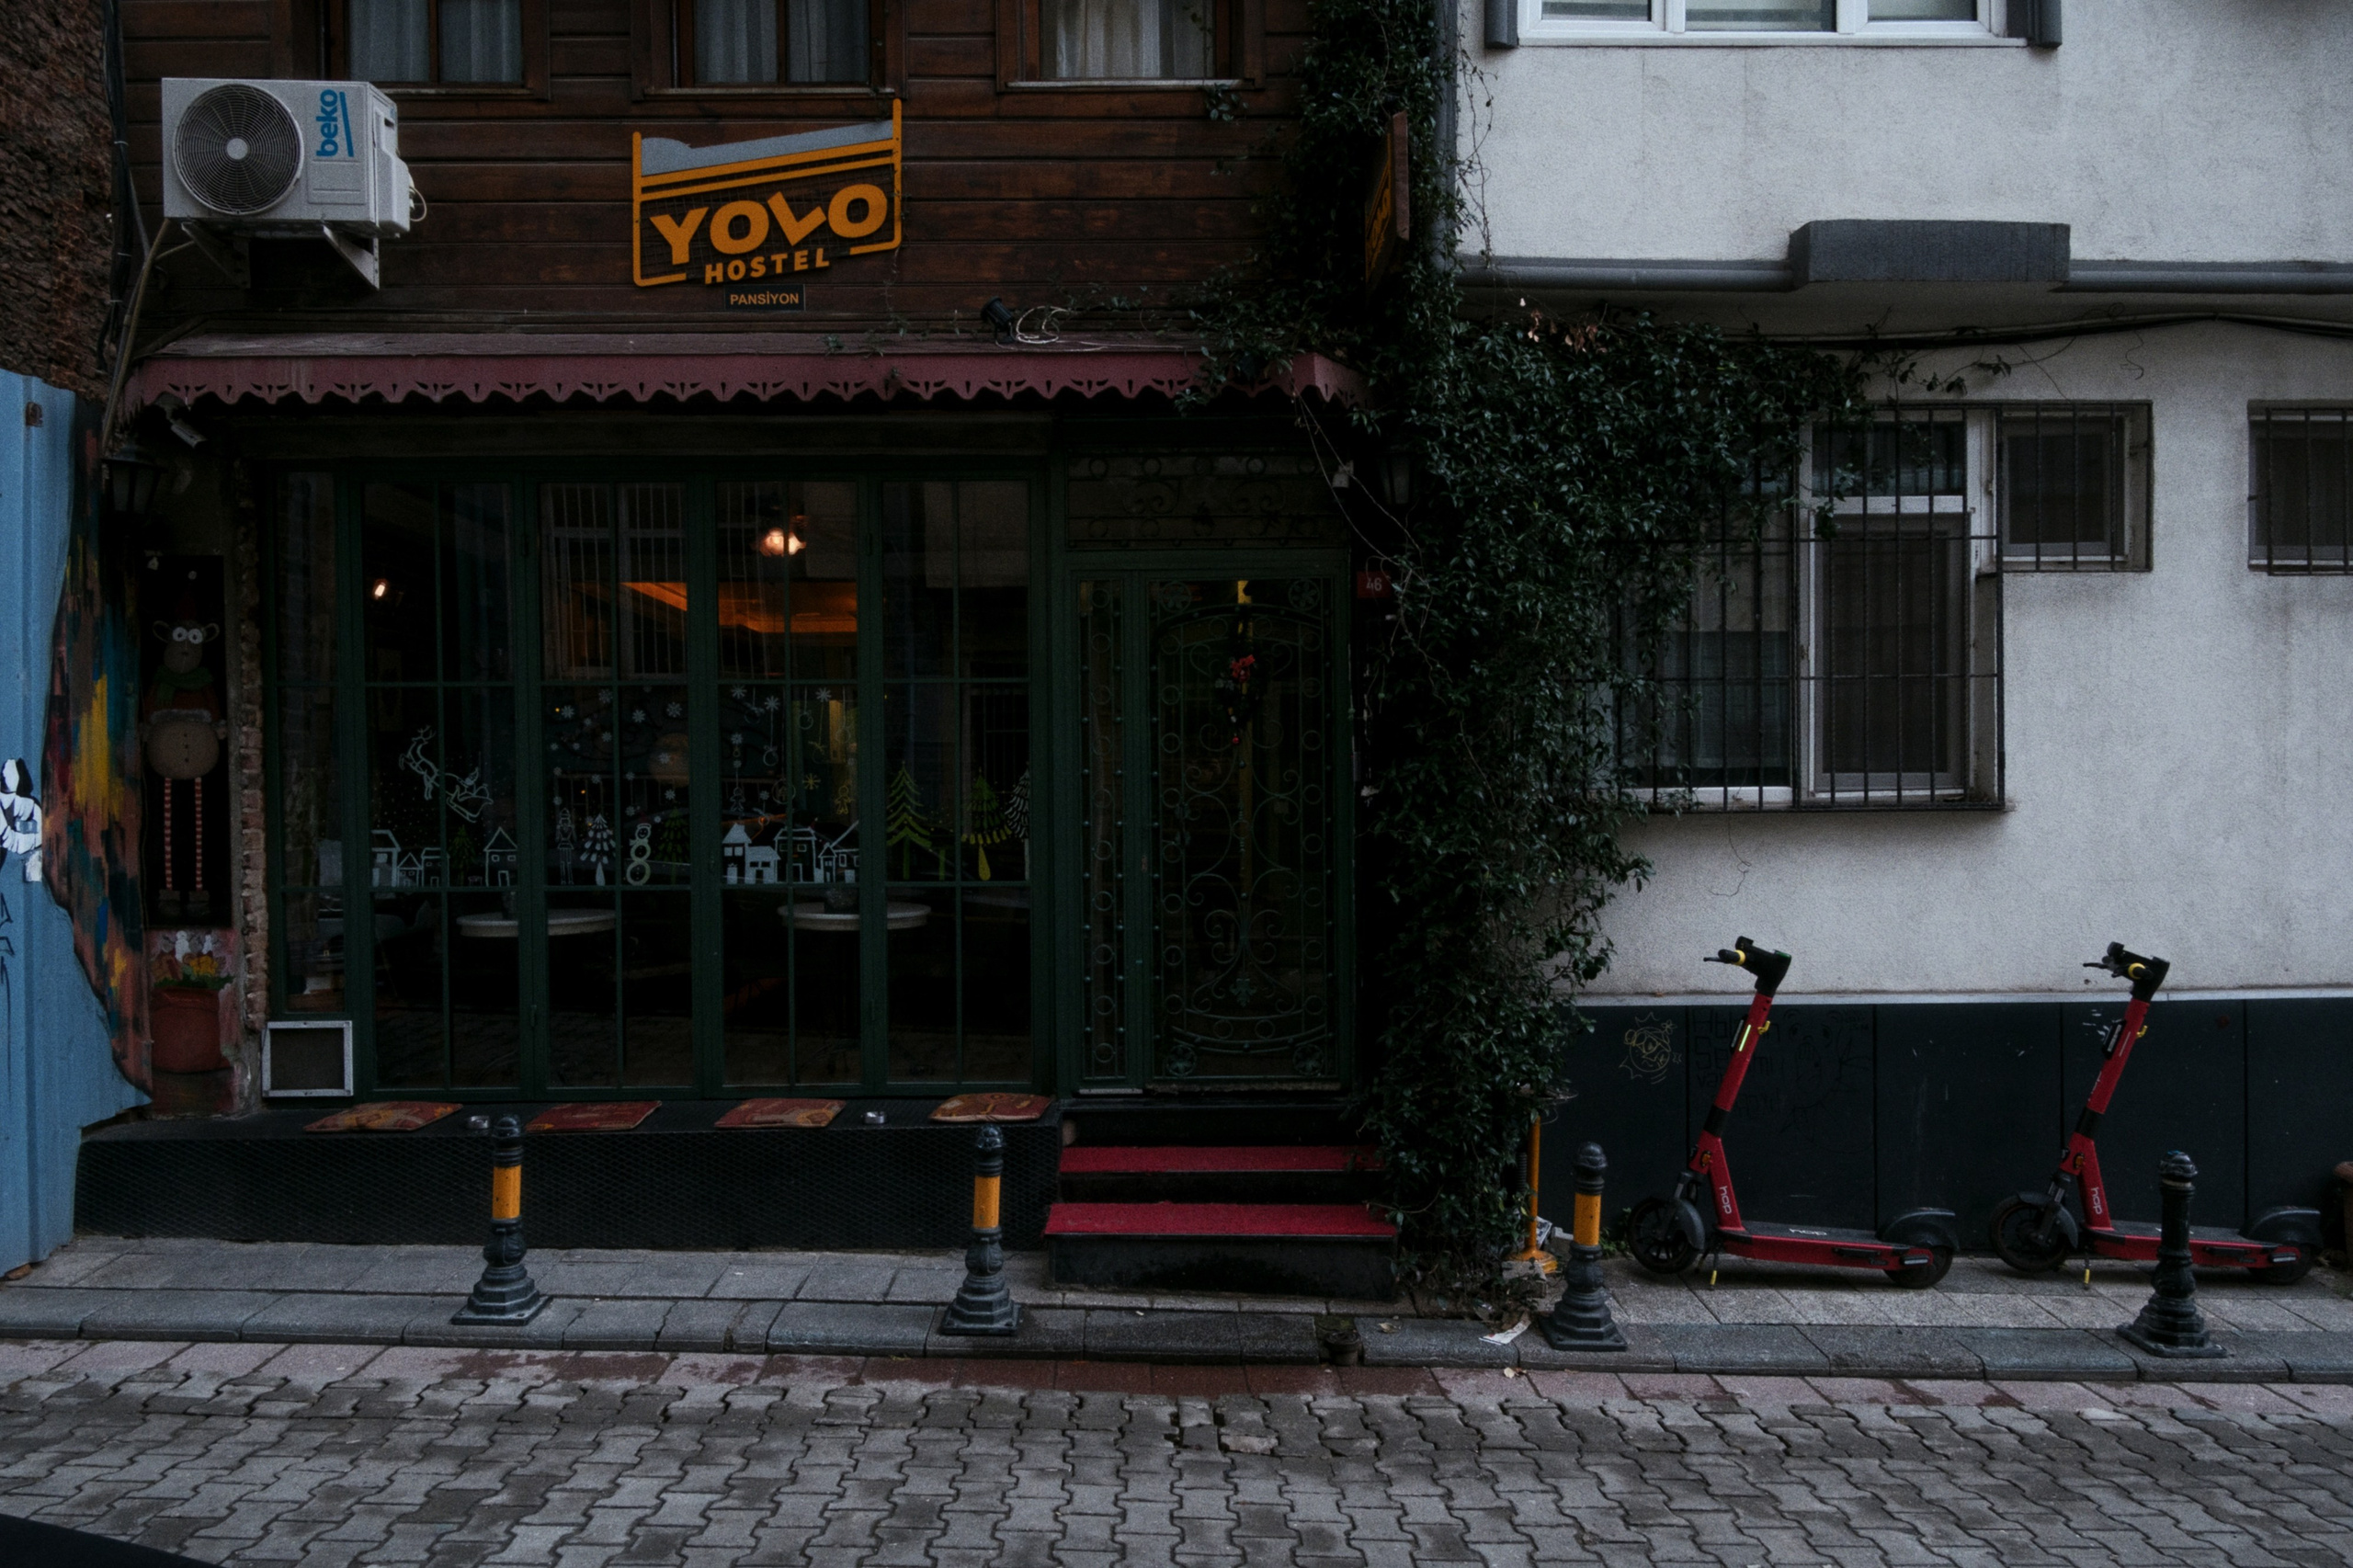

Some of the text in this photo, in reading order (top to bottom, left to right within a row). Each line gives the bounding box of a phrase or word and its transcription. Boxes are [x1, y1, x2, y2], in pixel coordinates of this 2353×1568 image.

[316, 89, 338, 156] beko
[649, 183, 888, 266] YOLO
[704, 247, 830, 285] HOSTEL
[730, 290, 799, 306] PANSİYON
[1366, 577, 1382, 592] 46
[1719, 1186, 1733, 1214] hop
[2091, 1187, 2103, 1215] hop
